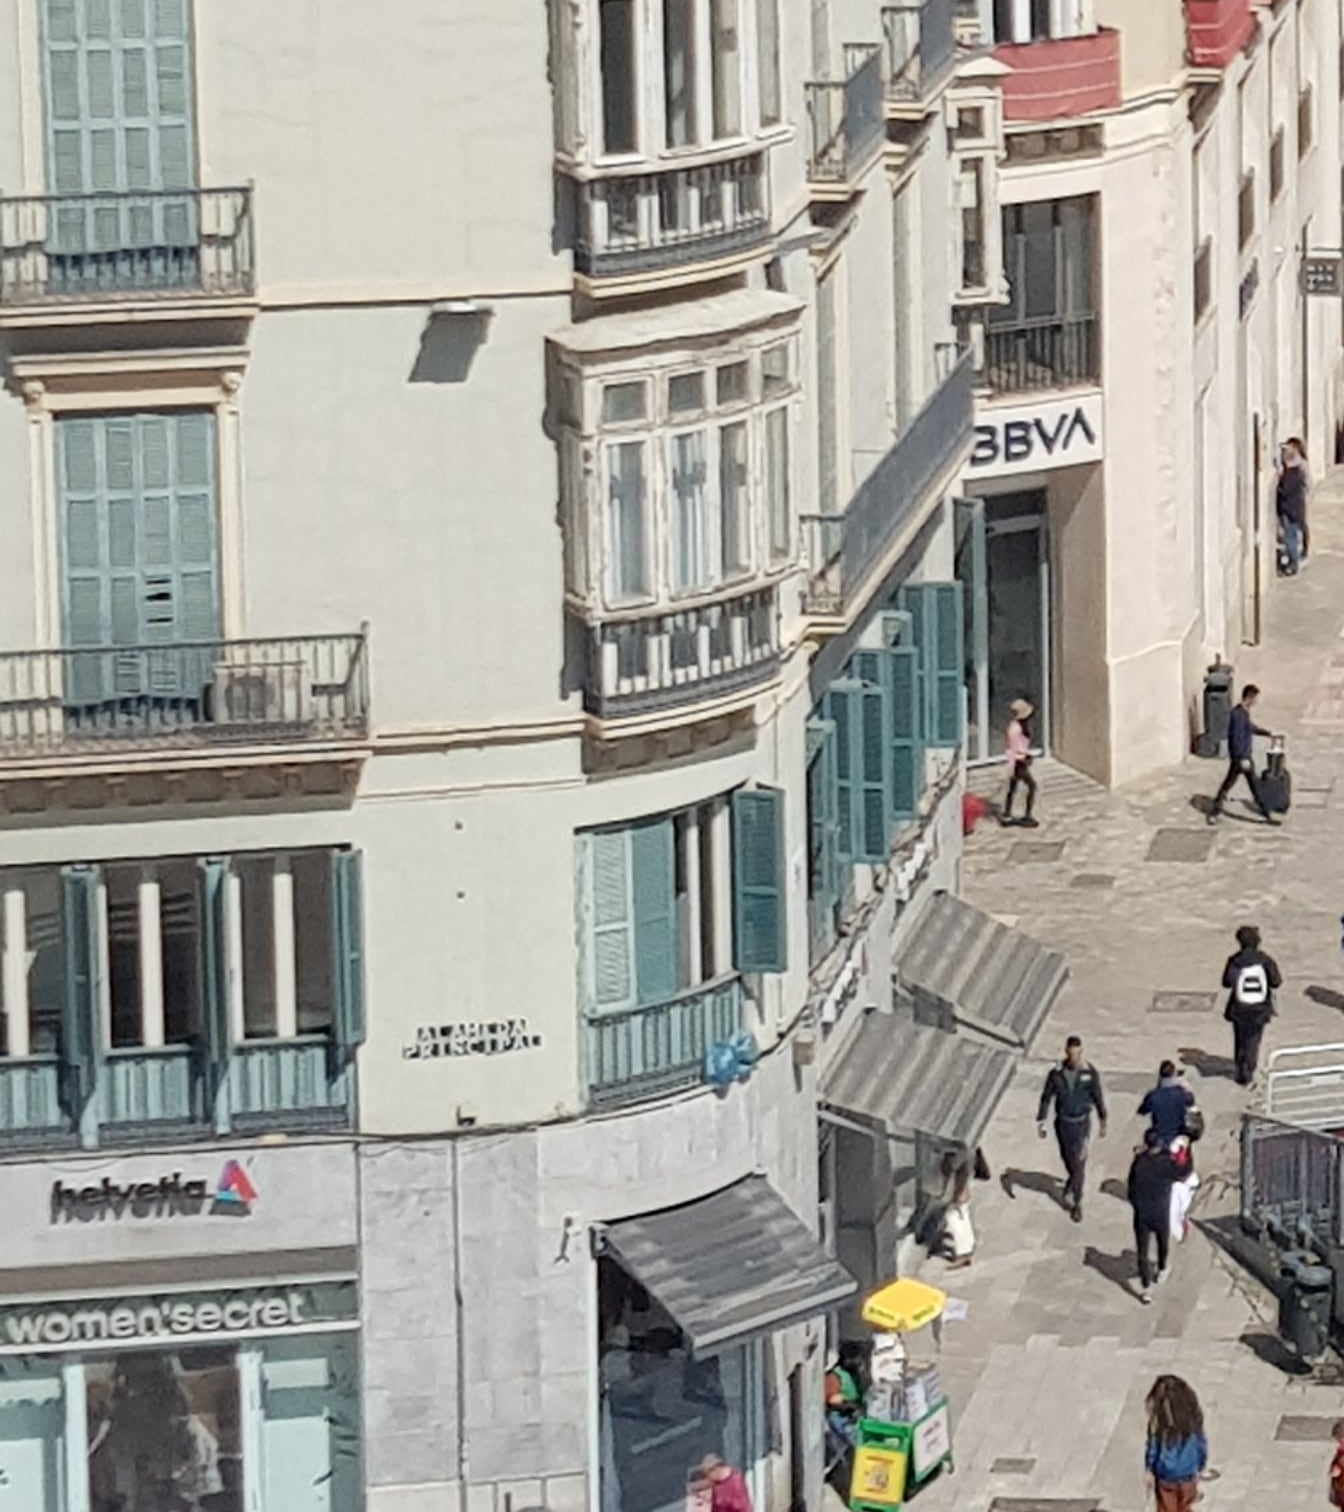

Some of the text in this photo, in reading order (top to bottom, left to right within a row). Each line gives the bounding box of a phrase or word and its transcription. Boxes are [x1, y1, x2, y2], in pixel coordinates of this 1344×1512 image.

[970, 407, 1096, 467] BBVA
[51, 1172, 208, 1212] helvetia
[5, 1291, 305, 1344] women'secret
